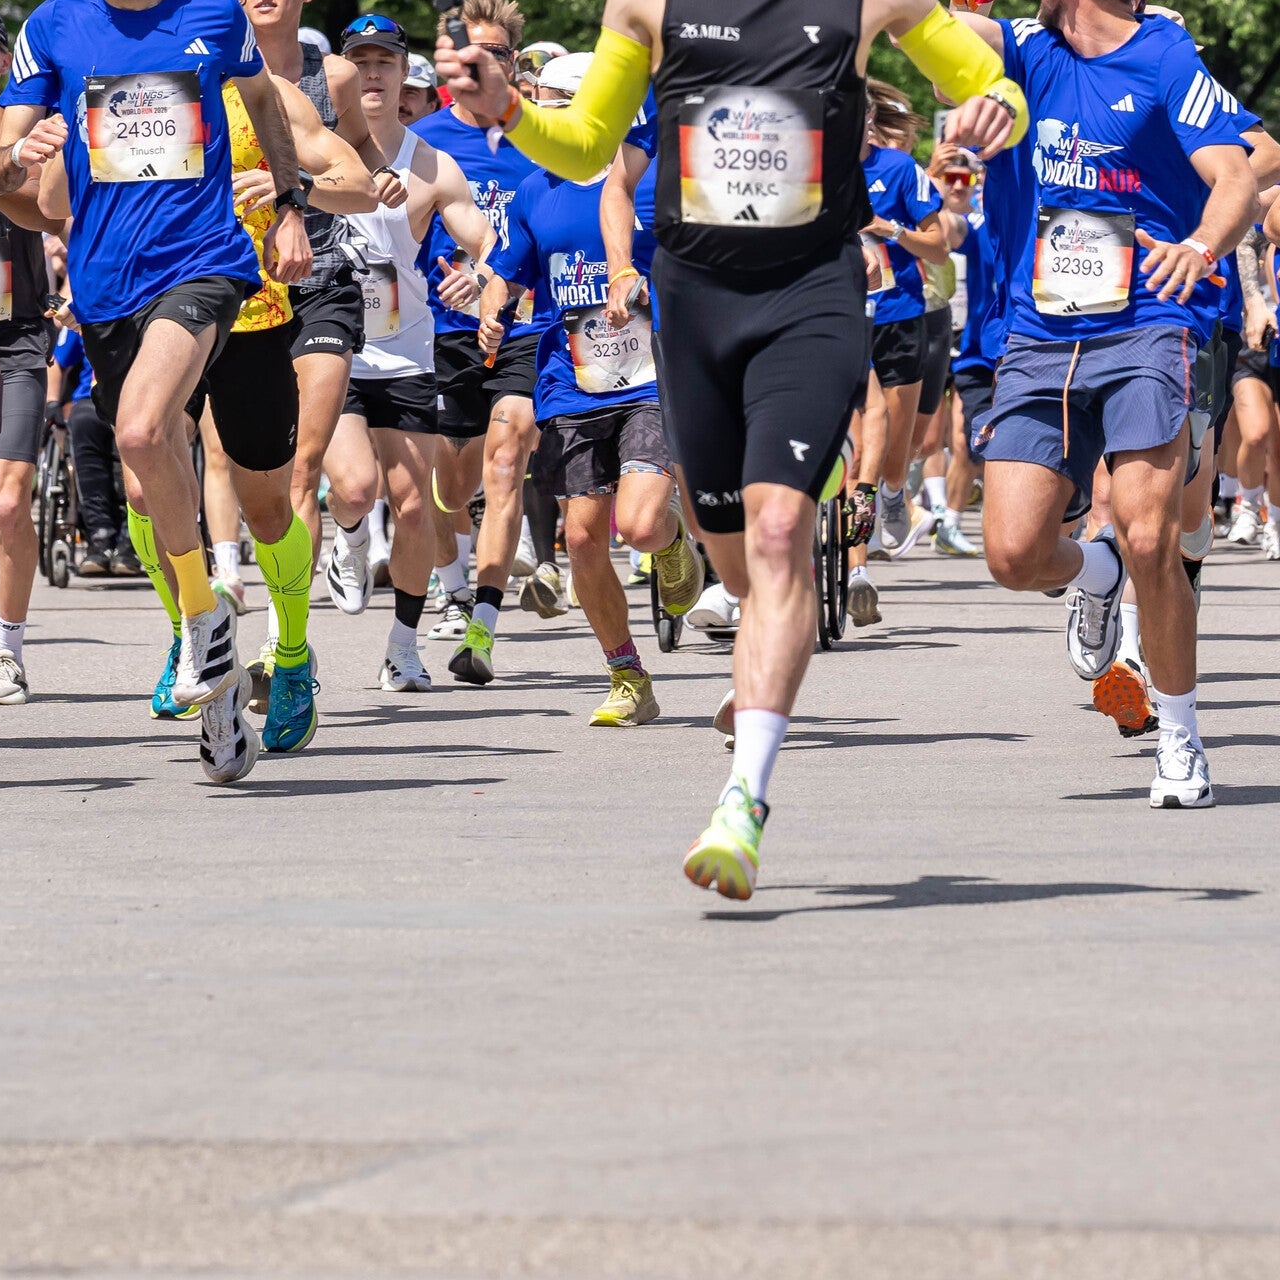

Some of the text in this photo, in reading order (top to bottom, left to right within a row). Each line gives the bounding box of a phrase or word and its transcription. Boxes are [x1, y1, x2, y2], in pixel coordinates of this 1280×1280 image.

[129, 91, 163, 100] WINGS
[134, 100, 153, 108] LIFE
[116, 120, 176, 139] 24306
[130, 146, 165, 156] Tinusch
[182, 159, 189, 171] 1
[713, 148, 787, 171] 32996
[1043, 157, 1141, 193] WORLD RUN
[727, 181, 779, 196] MARC
[566, 264, 608, 275] WINGS
[1052, 257, 1103, 276] 32393
[571, 275, 595, 285] LIFE
[558, 283, 609, 306] WORLD
[314, 336, 343, 346] TERREX
[593, 337, 639, 357] 32310
